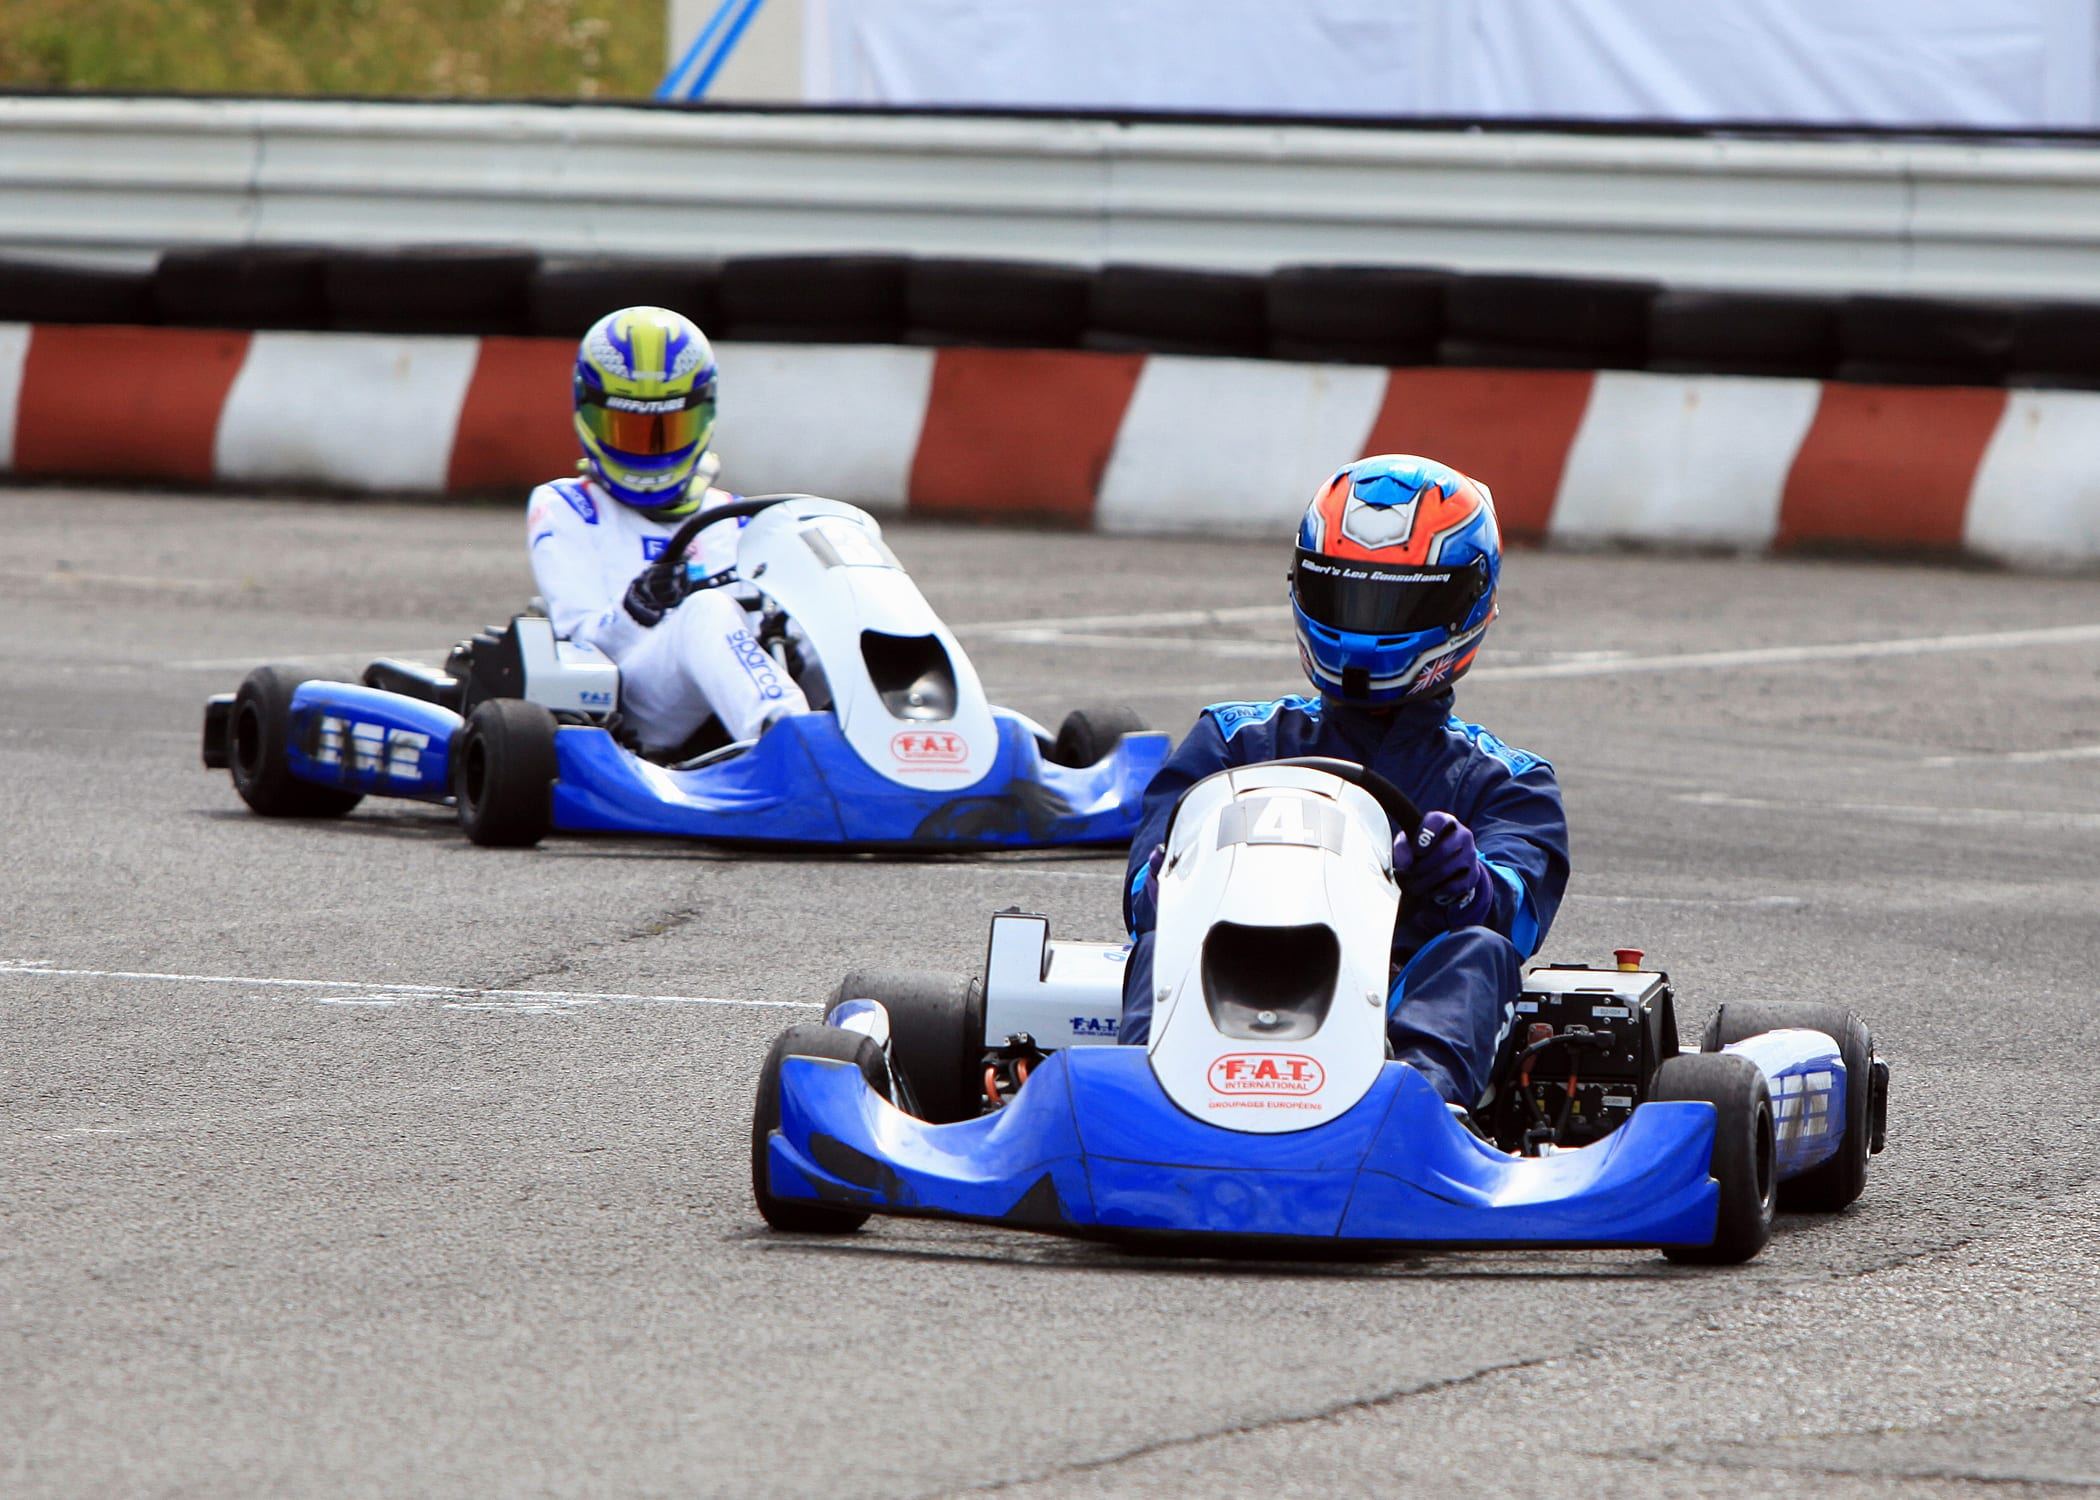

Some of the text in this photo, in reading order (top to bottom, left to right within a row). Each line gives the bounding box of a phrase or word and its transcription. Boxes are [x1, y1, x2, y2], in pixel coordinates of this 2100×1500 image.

[732, 630, 783, 699] sparco
[1251, 797, 1315, 844] 4
[1225, 1081, 1309, 1091] INTERNATIONAL
[1208, 1101, 1265, 1109] GROUPAGES
